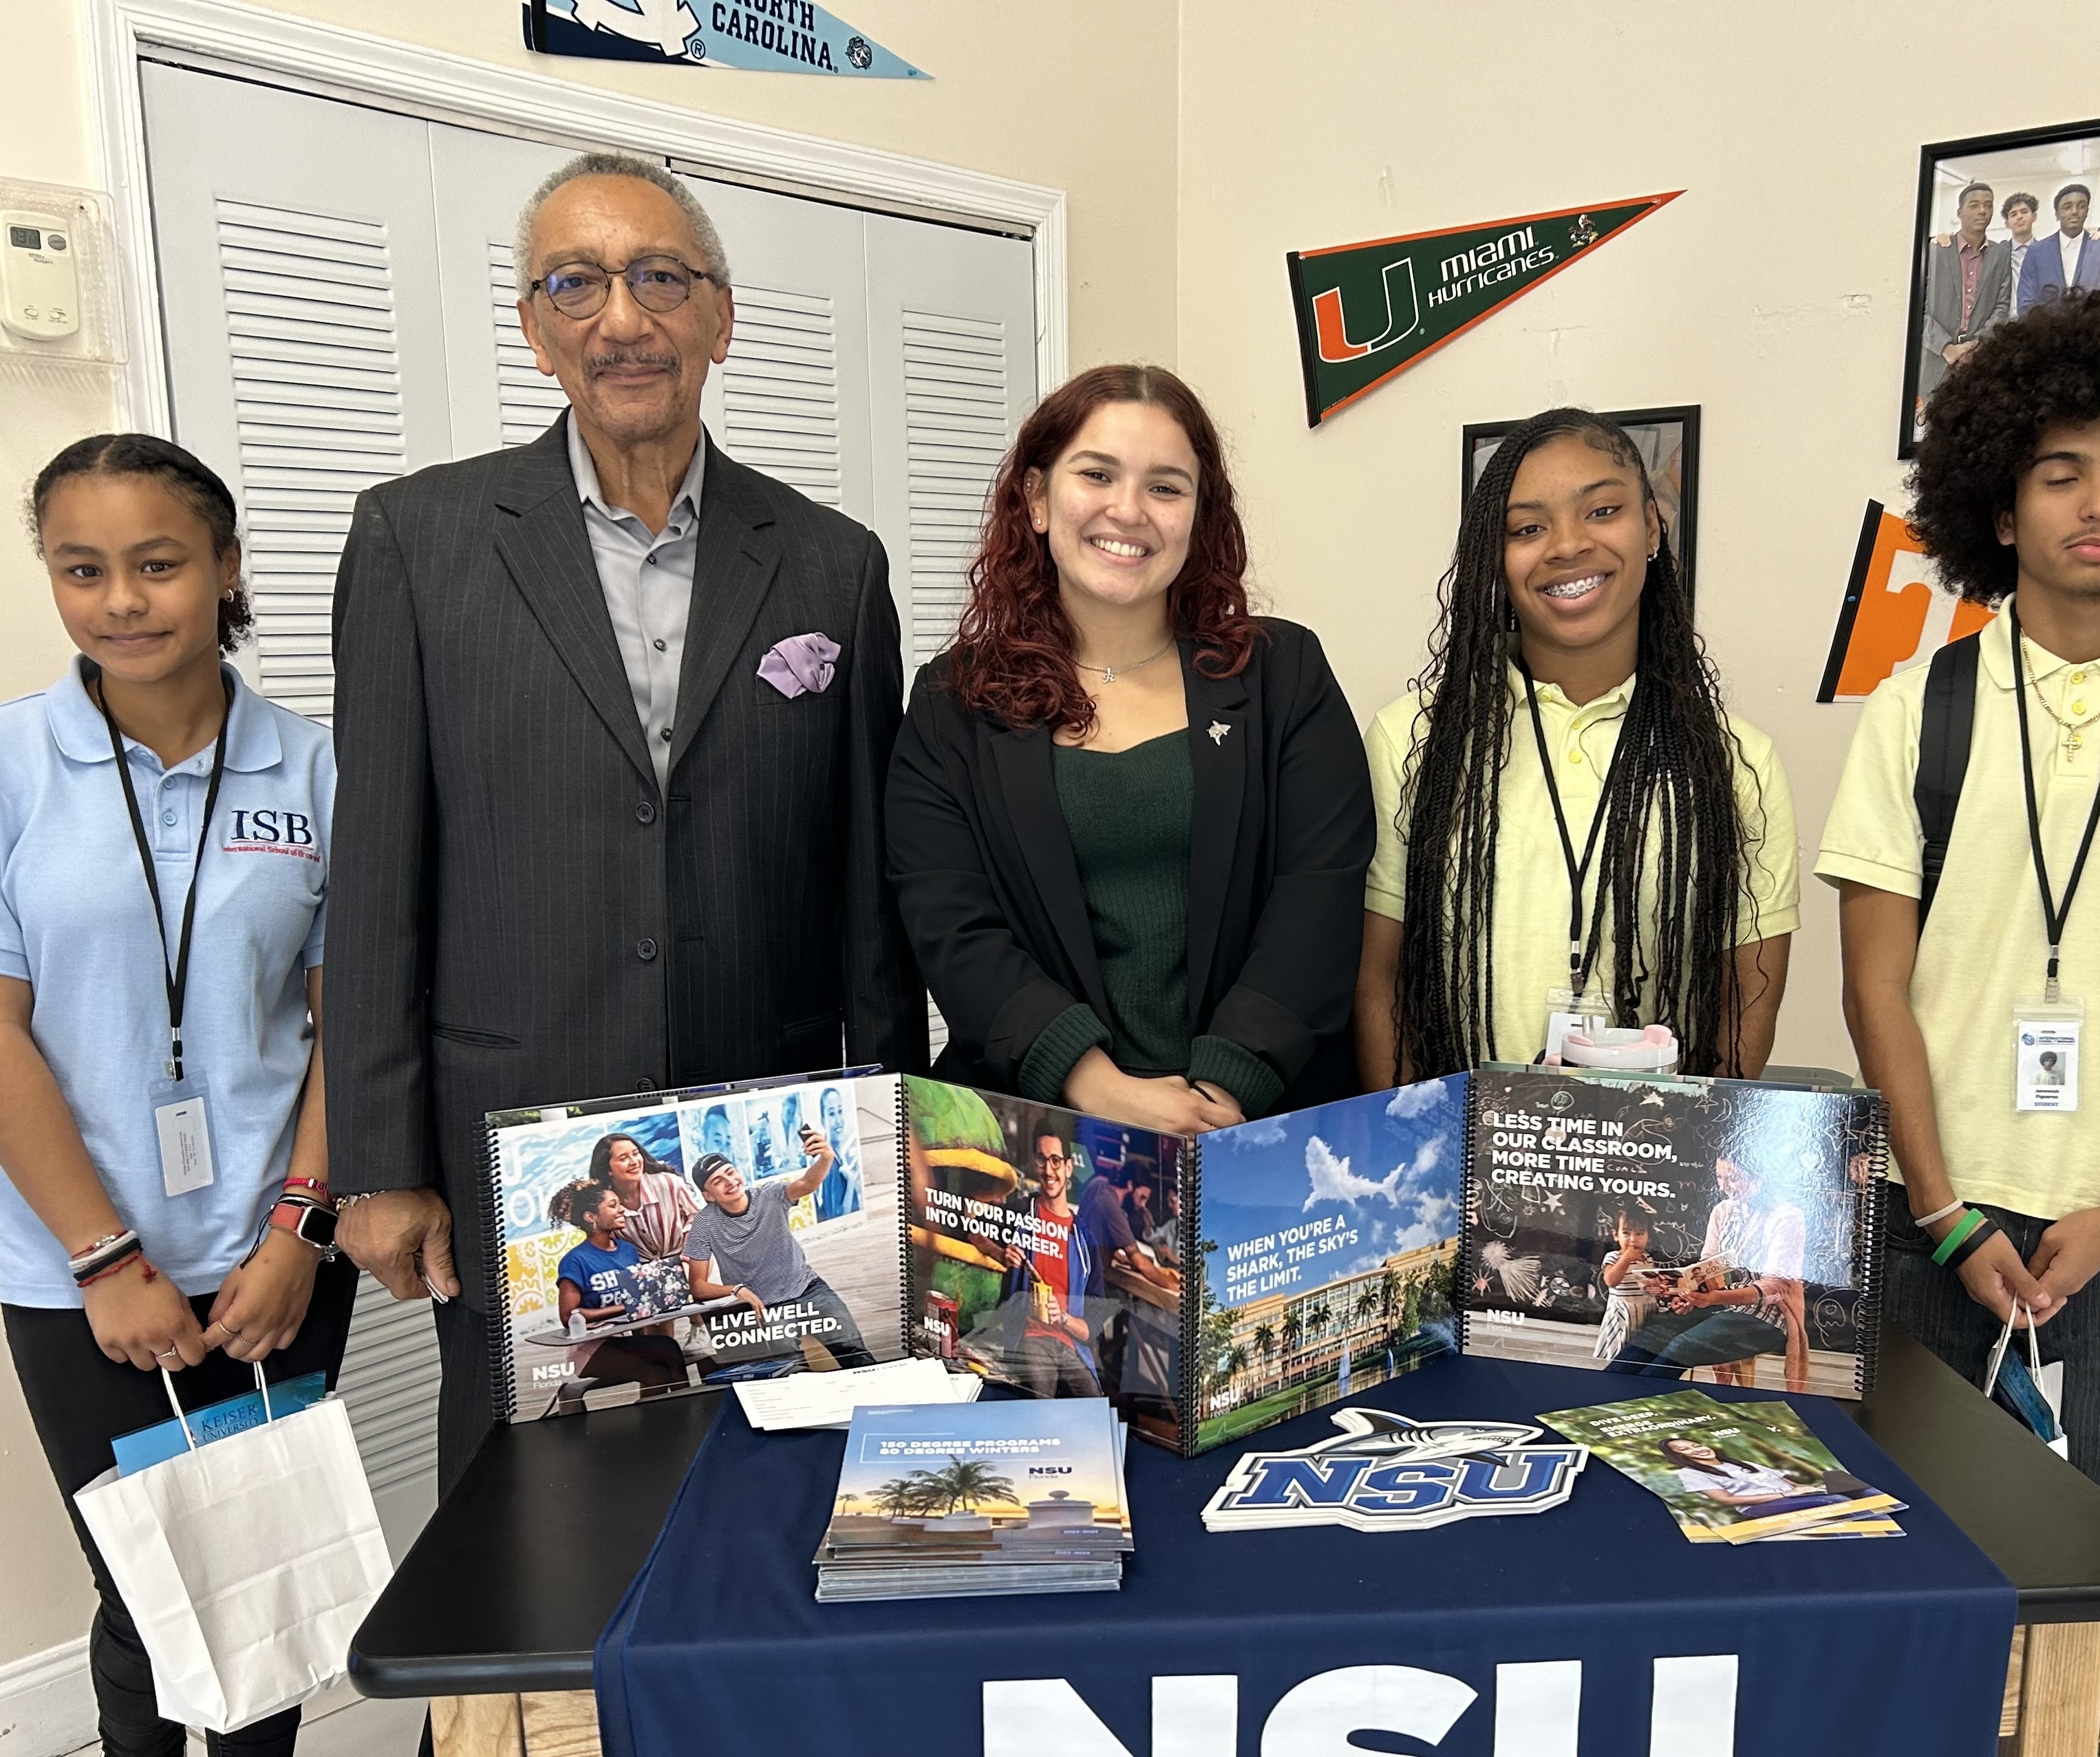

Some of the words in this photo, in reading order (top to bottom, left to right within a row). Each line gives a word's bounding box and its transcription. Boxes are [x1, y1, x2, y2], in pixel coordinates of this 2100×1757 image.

[712, 2, 833, 71] CAROLINA
[231, 809, 312, 844] ISB
[1493, 1112, 1543, 1131] LESS
[1547, 1116, 1596, 1136] TIME
[1600, 1120, 1624, 1137] IN
[1492, 1131, 1536, 1150] OUR
[1541, 1136, 1678, 1163] CLASSROOM,
[1492, 1150, 1551, 1169] MORE
[1555, 1154, 1605, 1173] TIME
[1491, 1169, 1594, 1192] CREATING
[1598, 1176, 1676, 1198] YOURS.
[924, 1187, 962, 1211] TURN
[964, 1197, 1004, 1223] YOUR
[1005, 1209, 1069, 1242] PASSION
[925, 1206, 958, 1228] INTO
[961, 1215, 999, 1241] YOUR
[1001, 1228, 1064, 1259] CAREER.
[1227, 1233, 1275, 1262] WHEN
[1278, 1217, 1332, 1246] YOU'RE
[1334, 1213, 1347, 1231] A
[1227, 1252, 1283, 1283] SHARK,
[1286, 1241, 1316, 1264] THE
[1318, 1228, 1359, 1255] SKY'S
[1226, 1279, 1257, 1303] THE
[1260, 1265, 1303, 1292] LIMIT.
[710, 1310, 757, 1332] LIVE
[762, 1301, 820, 1323] WELL
[923, 1315, 950, 1337] NSU
[1487, 1308, 1525, 1325] NSU
[711, 1316, 843, 1350] CONNECTED.
[533, 1361, 575, 1381] NSU
[1210, 1387, 1241, 1412] NSU
[201, 1403, 257, 1432] KEISER
[202, 1417, 259, 1442] UNIVERSITY
[1589, 1416, 1622, 1427] DIVE
[1621, 1412, 1659, 1423] DEEP.
[1599, 1420, 1653, 1433] EMERGE
[1606, 1414, 1717, 1438] EXTRAORDINARY.
[969, 1446, 1040, 1454] WINTERS
[975, 1438, 1061, 1447] PROGRAMS
[1234, 1450, 1574, 1515] NSU
